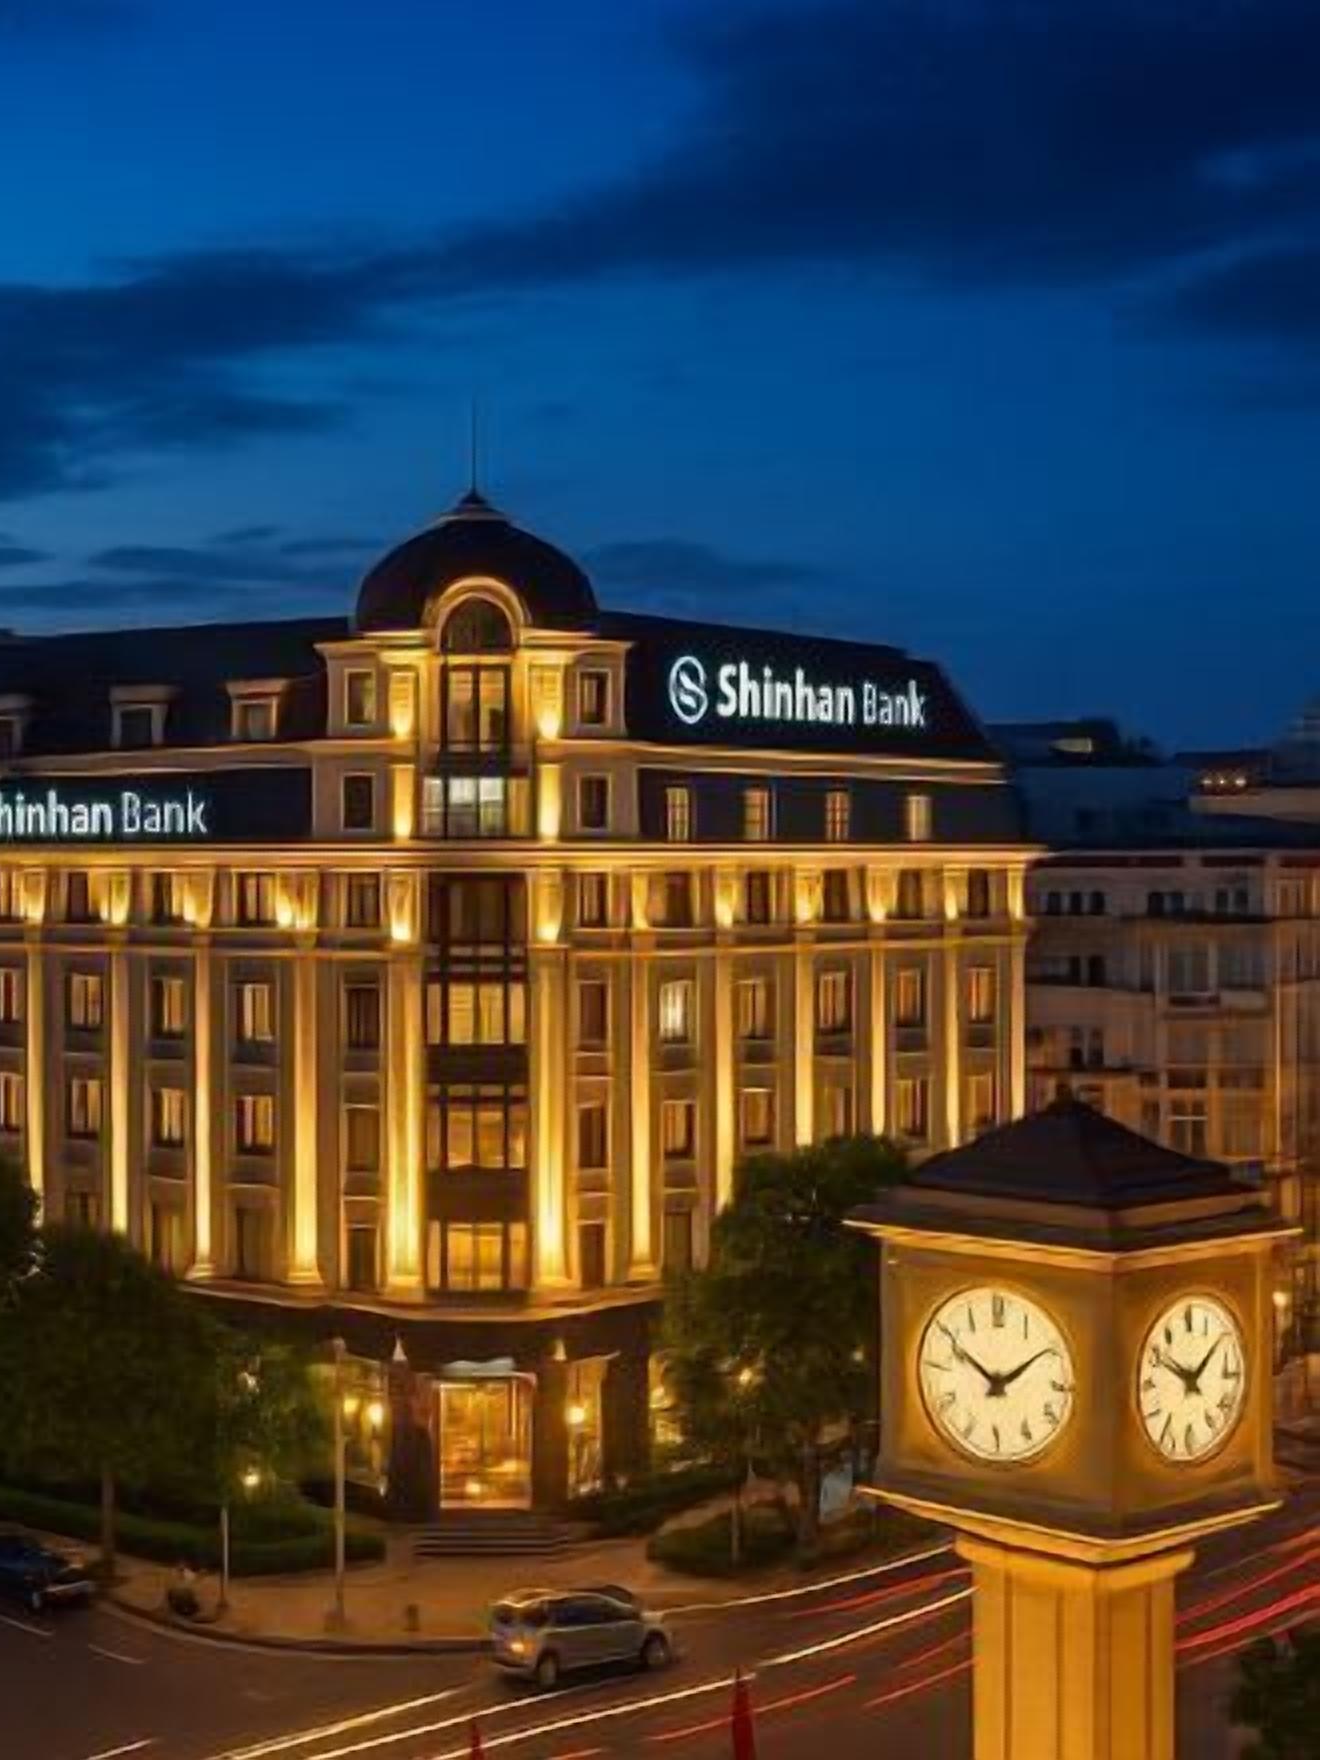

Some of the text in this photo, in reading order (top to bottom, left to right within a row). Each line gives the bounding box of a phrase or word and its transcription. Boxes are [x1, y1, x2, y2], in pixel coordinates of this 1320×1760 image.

[716, 660, 926, 727] Shinhan Bank
[121, 790, 208, 835] Bank
